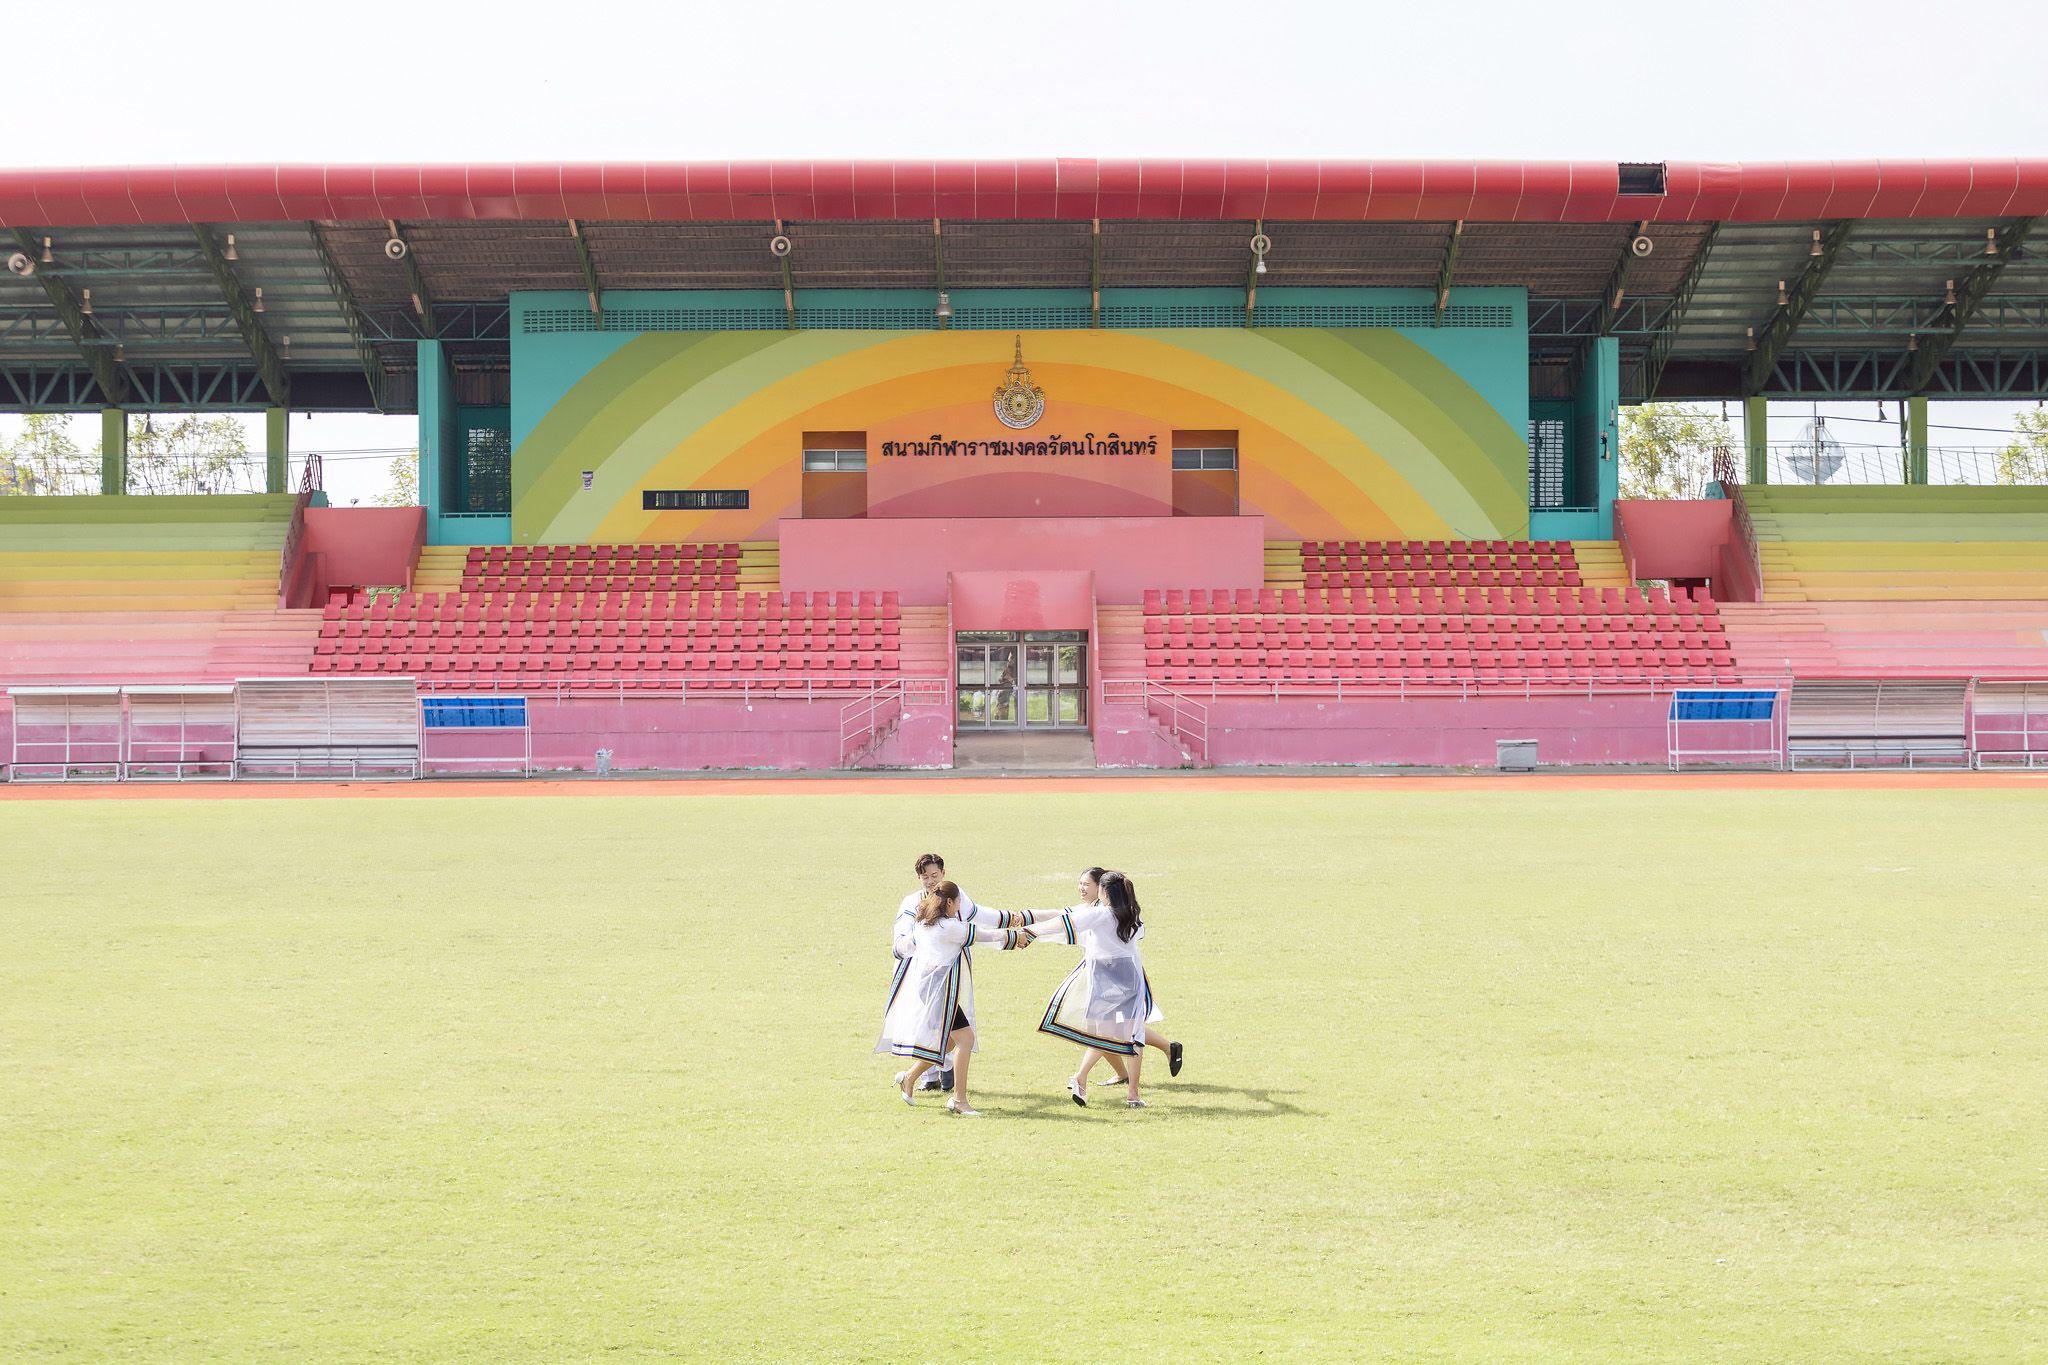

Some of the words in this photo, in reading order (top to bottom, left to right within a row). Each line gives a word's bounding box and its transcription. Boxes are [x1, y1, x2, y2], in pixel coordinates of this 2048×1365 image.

[882, 433, 1157, 456] สนามกีฬาราชมงคลรัตนโกสินทร์
